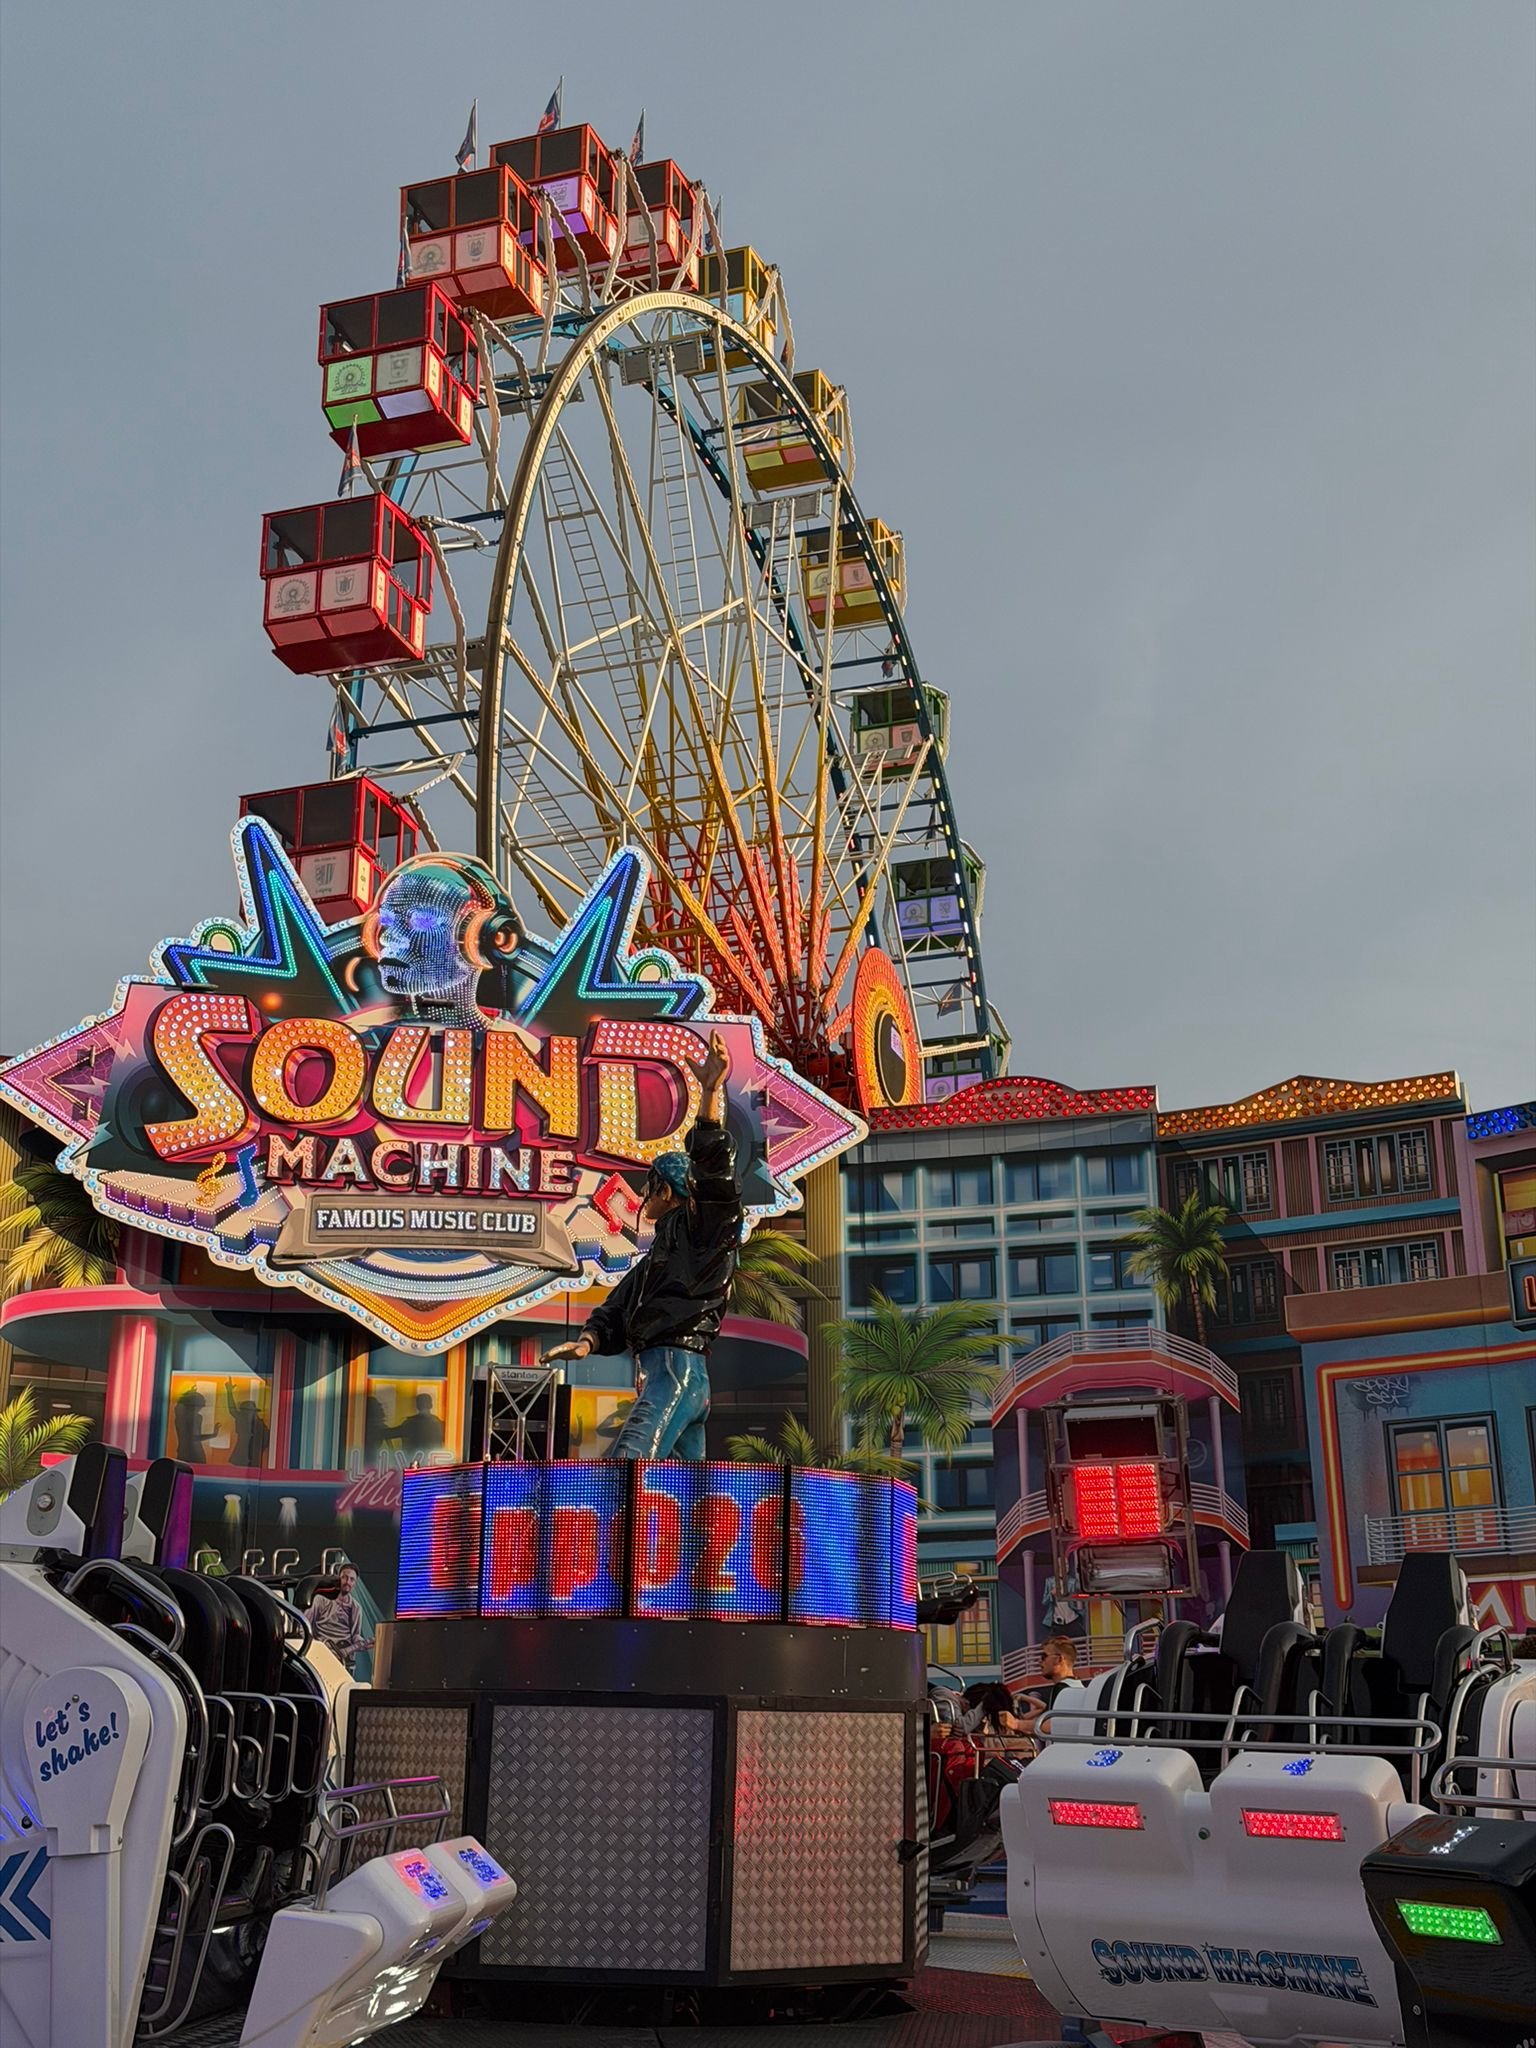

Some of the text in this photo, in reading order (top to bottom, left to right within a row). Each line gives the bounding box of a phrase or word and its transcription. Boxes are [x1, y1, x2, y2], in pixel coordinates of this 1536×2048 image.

[143, 991, 710, 1166] SOUND
[267, 1133, 578, 1196] MACHINE
[317, 1208, 536, 1234] FAMOUS MUSIC CLUB
[501, 1369, 538, 1380] stanton
[40, 1712, 120, 1782] shake!
[1086, 1749, 1123, 1767] 3
[1283, 1757, 1314, 1776] 4
[1091, 1937, 1378, 2008] SOUND MACHINE
